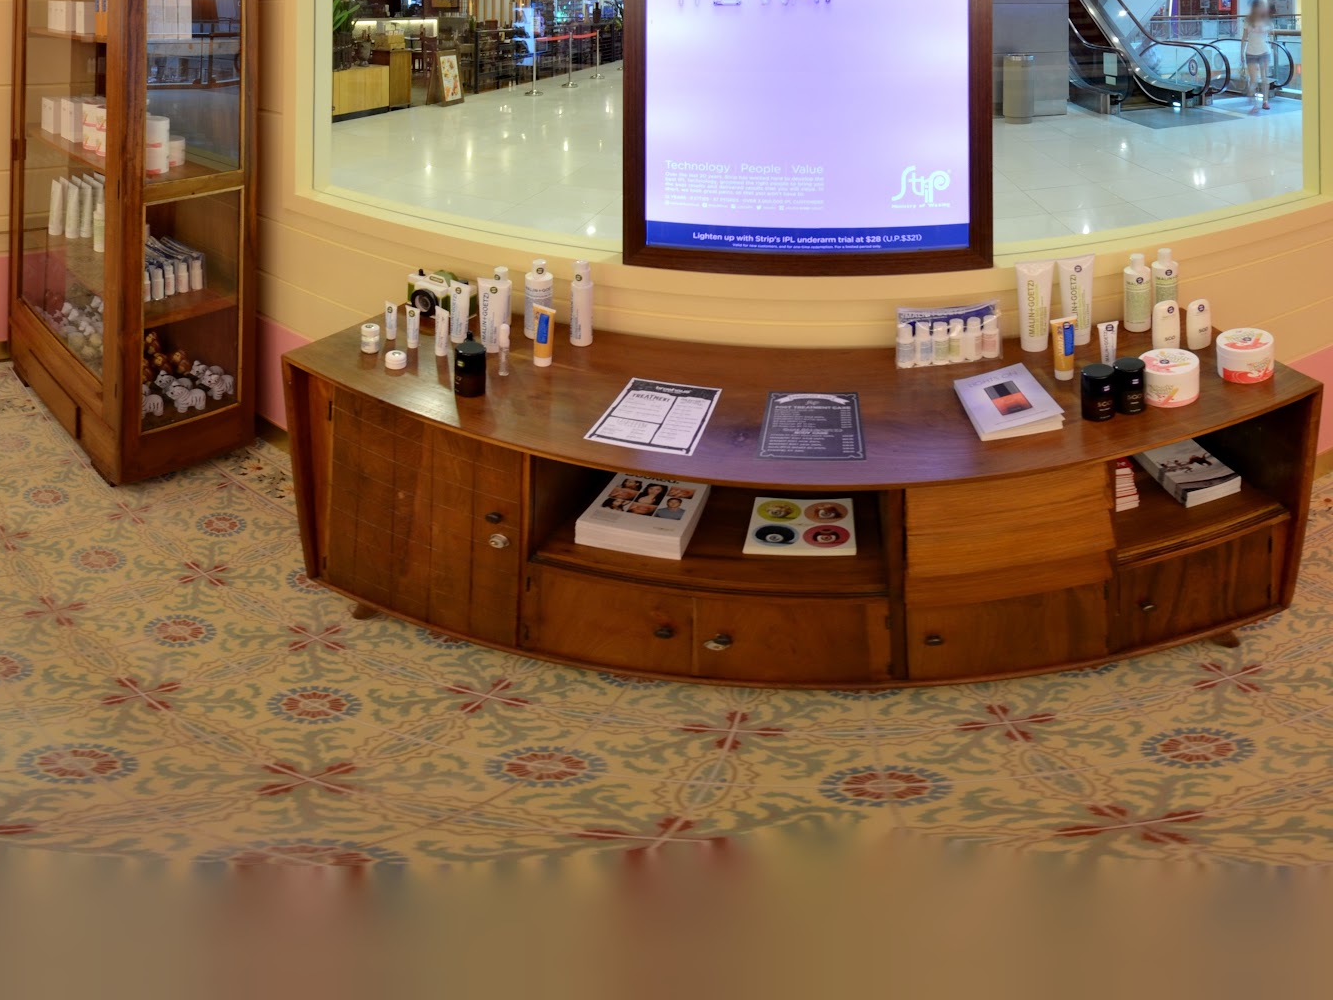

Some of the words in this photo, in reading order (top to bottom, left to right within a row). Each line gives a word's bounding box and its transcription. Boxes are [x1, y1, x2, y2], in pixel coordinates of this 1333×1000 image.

[664, 159, 730, 173] Technology
[741, 163, 781, 174] People
[791, 164, 824, 174] Value
[692, 231, 722, 241] Lighten
[723, 234, 735, 242] up
[736, 233, 754, 242] with
[755, 234, 781, 244] Strip's
[782, 235, 795, 243] IPL
[796, 235, 836, 243] underarm
[838, 235, 854, 243] trial
[865, 235, 882, 244] $28
[882, 233, 922, 243] (U.P.$321)
[1028, 279, 1036, 338] (MALIN+GOETZ)
[632, 393, 671, 403] TREATMENT
